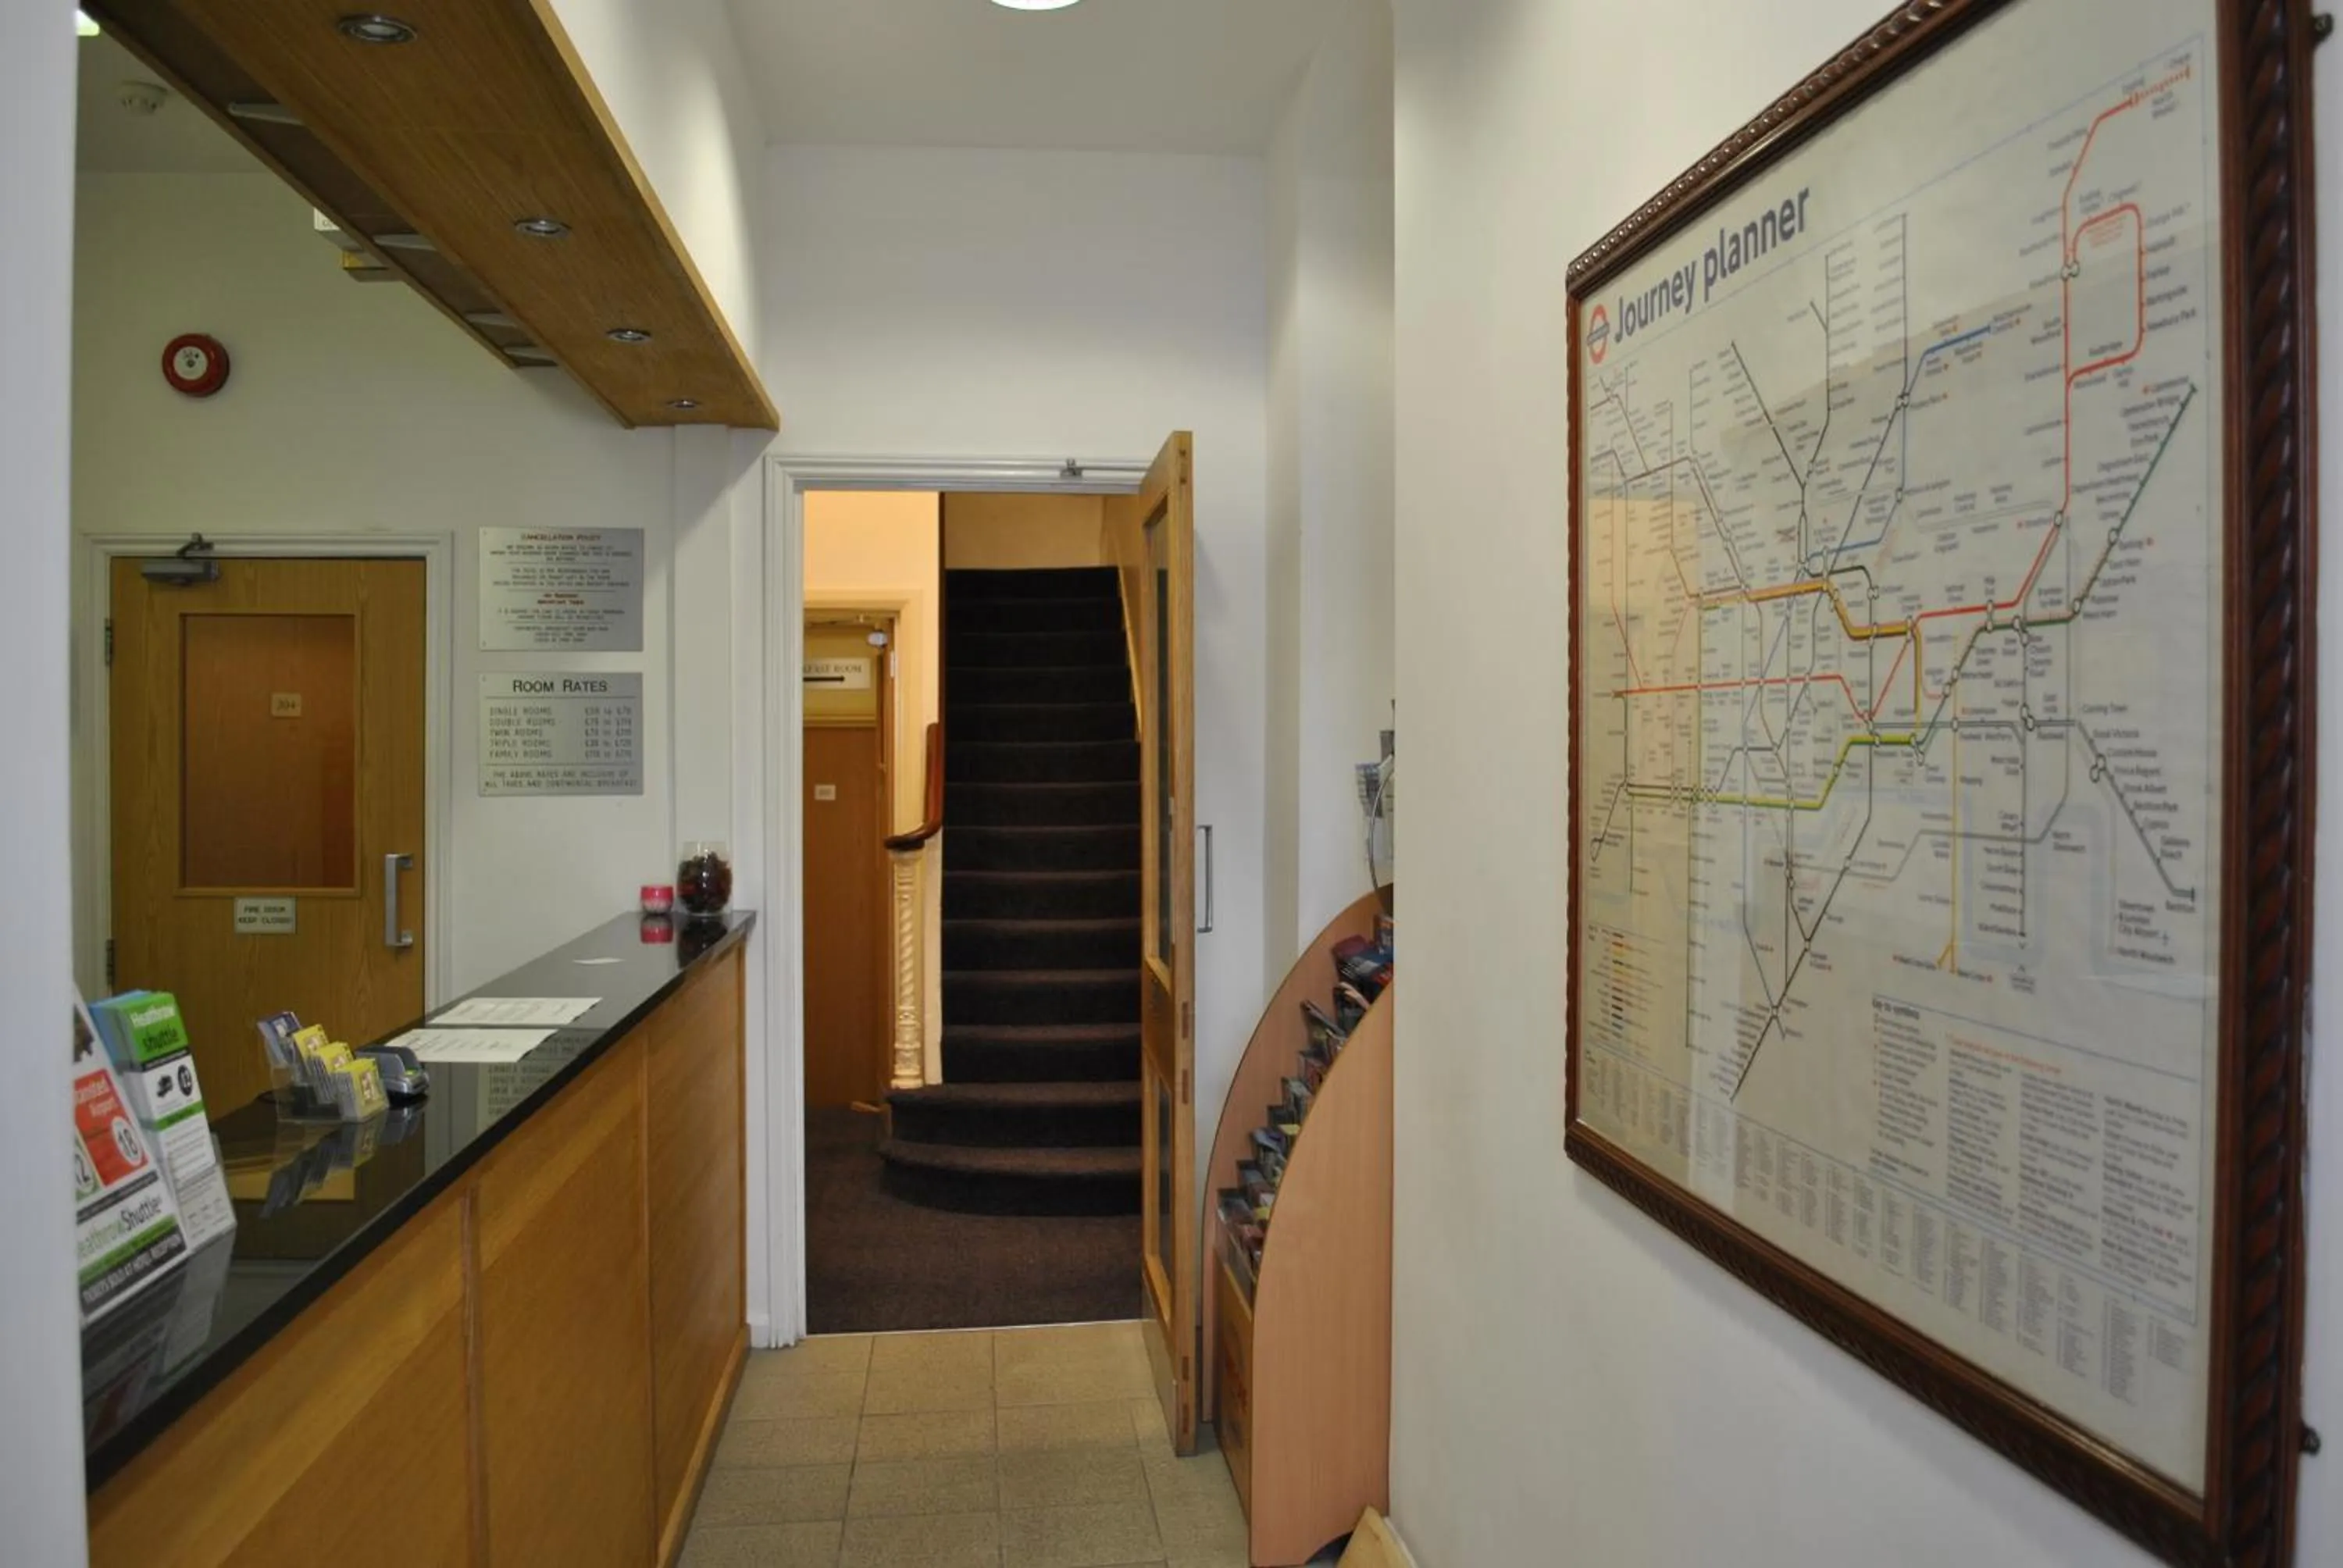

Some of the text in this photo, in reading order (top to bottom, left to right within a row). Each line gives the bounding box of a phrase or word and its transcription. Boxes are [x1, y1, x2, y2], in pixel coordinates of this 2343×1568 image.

[1614, 259, 1697, 344] Journey
[1703, 187, 1810, 303] planner
[512, 679, 608, 693] ROOM RATES
